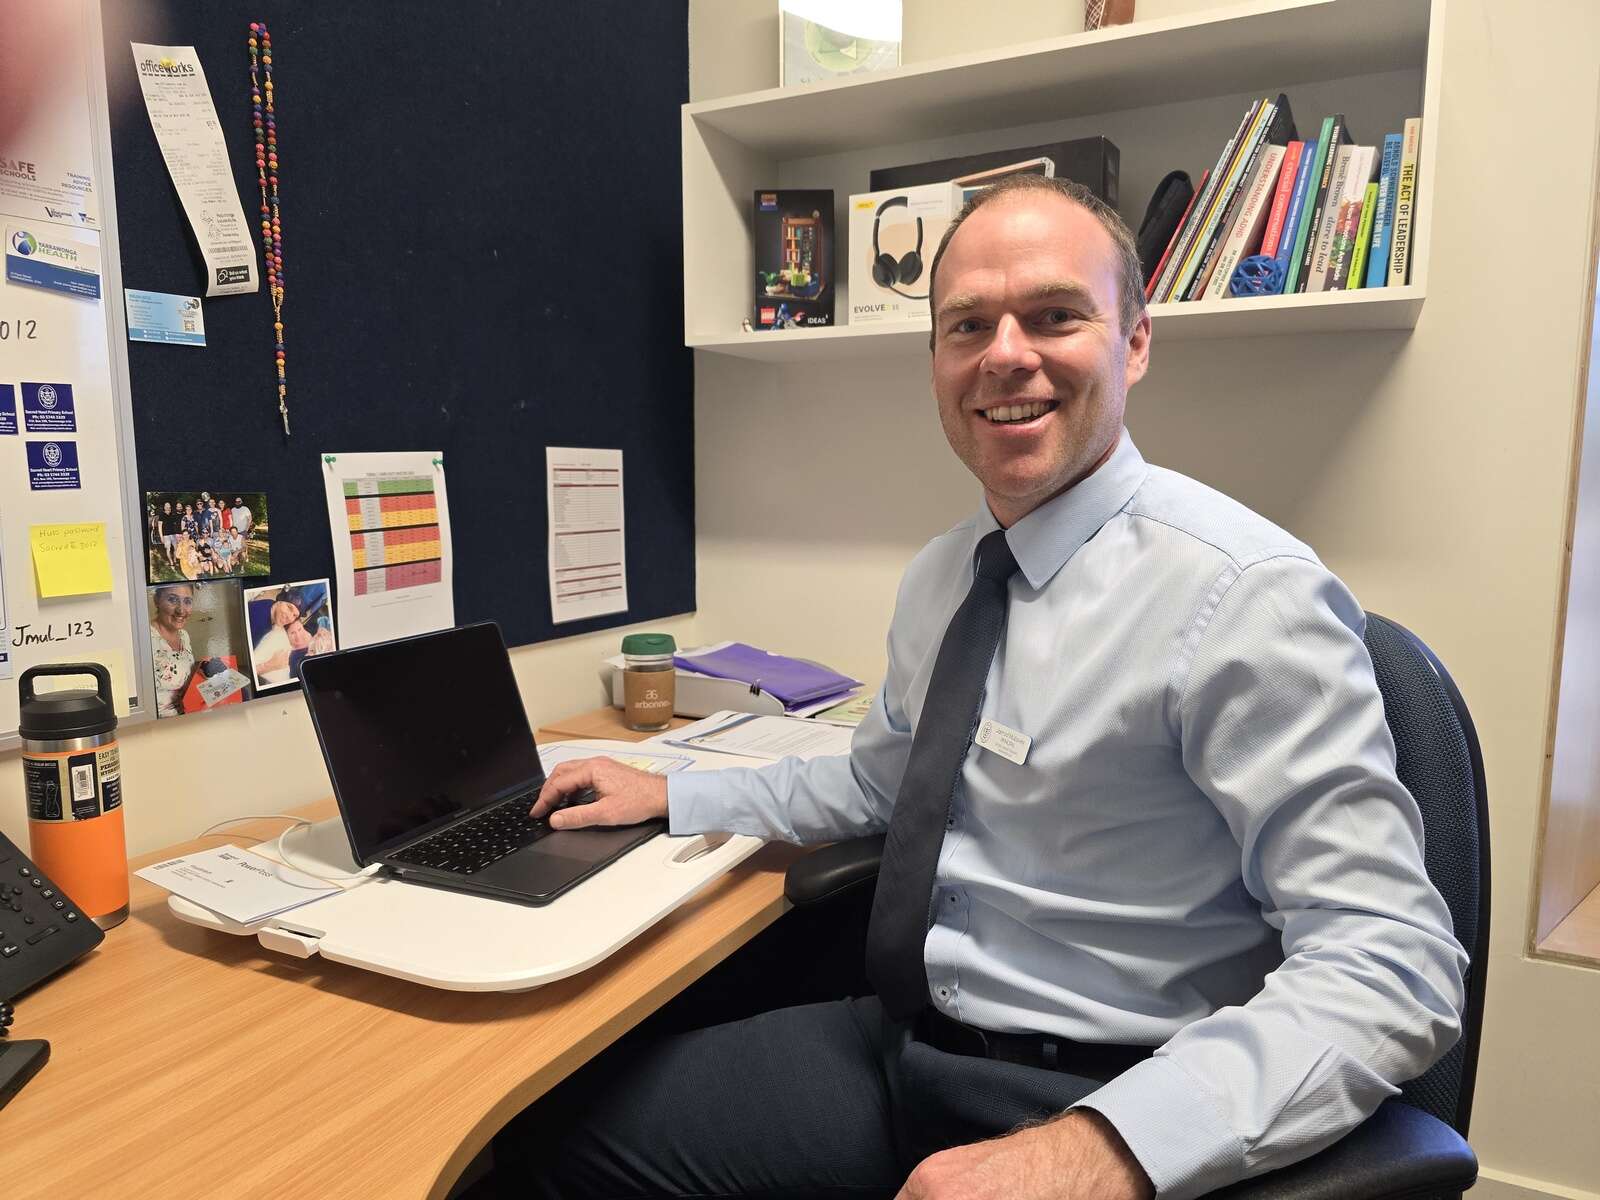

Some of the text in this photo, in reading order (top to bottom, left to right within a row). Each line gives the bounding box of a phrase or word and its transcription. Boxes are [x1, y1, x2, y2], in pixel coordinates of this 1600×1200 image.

[140, 60, 194, 74] officeworks
[0, 158, 36, 175] SAFE
[1382, 150, 1391, 176] USEFUL
[0, 170, 36, 182] SCHOOLS
[1403, 164, 1413, 180] THE
[1243, 151, 1277, 217] UNDERSTANDING
[1400, 183, 1411, 200] ACT
[1330, 180, 1342, 207] Brown
[1399, 204, 1409, 215] OF
[1234, 217, 1249, 238] ADHD
[38, 242, 77, 256] YARRAWONGA
[1314, 216, 1335, 273] dare to lead
[1392, 217, 1407, 273] LEADERSHIP
[38, 248, 78, 262] HEALTH
[12, 621, 94, 647] Jmul_123
[634, 700, 671, 708] arbonne
